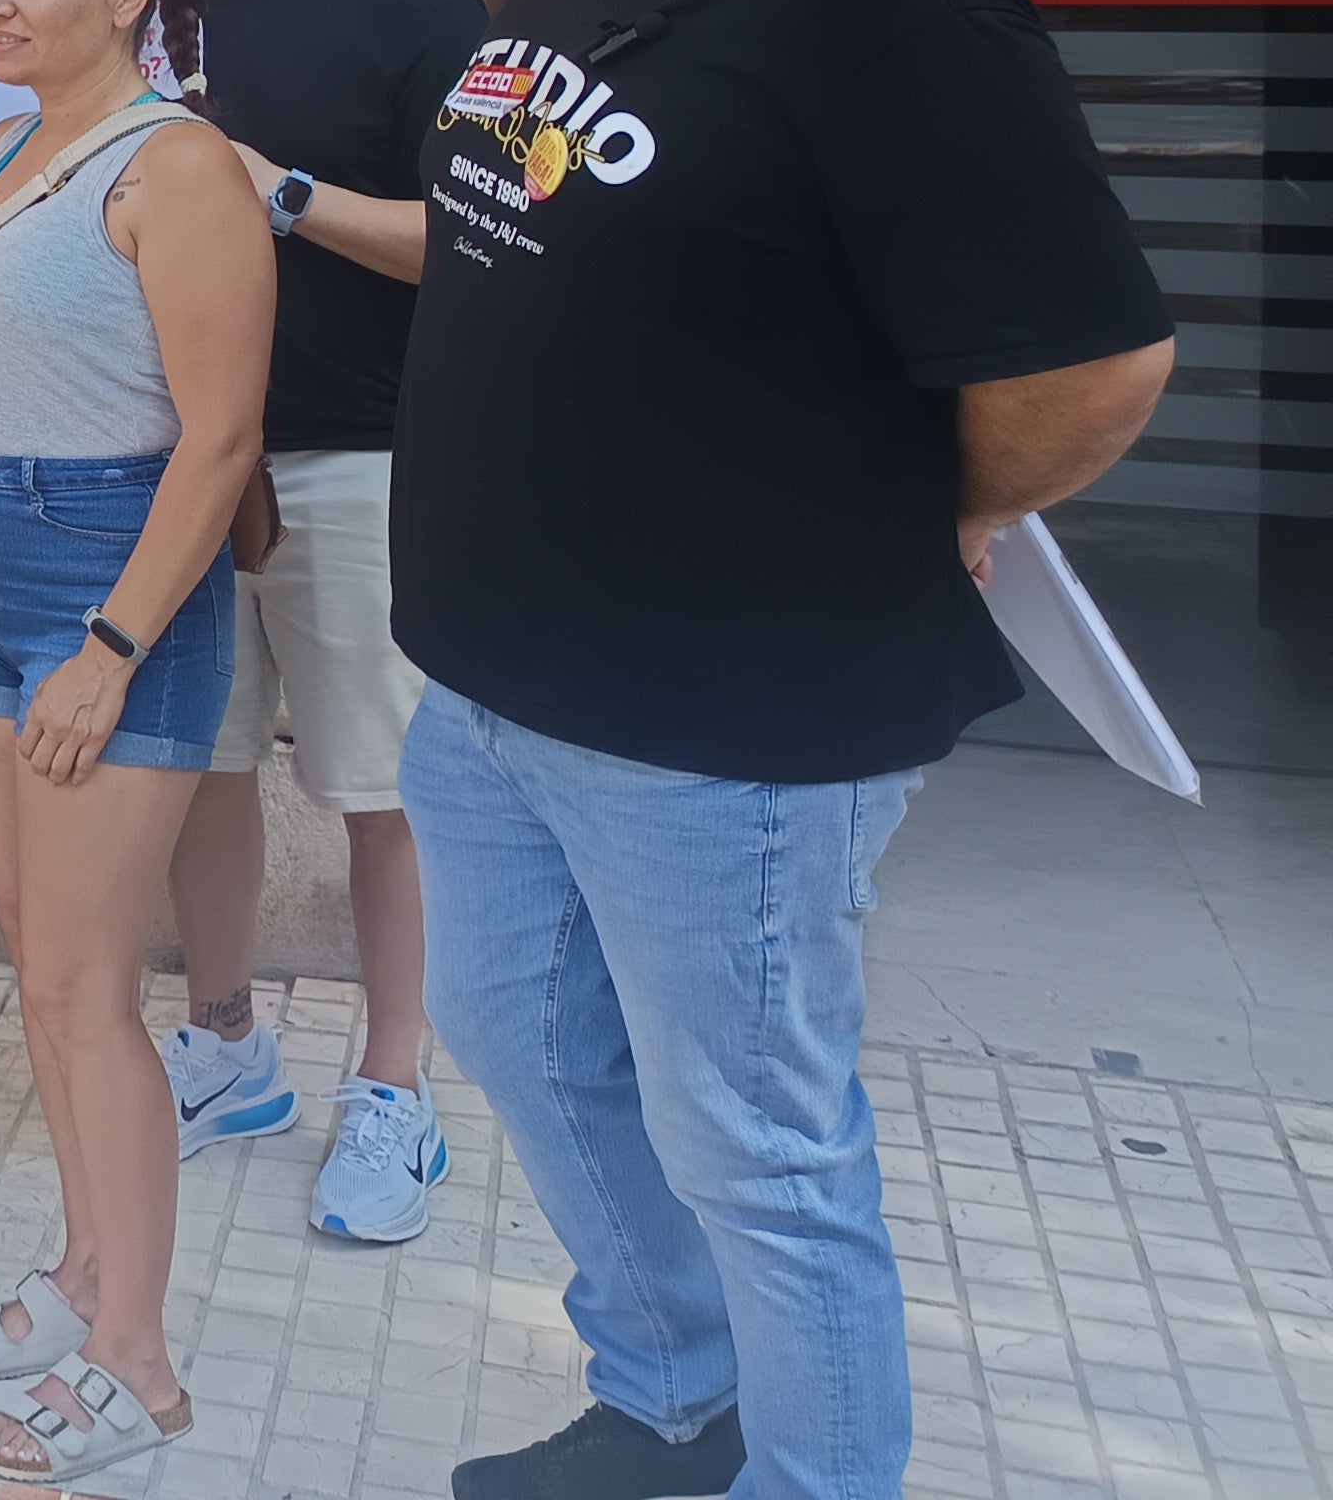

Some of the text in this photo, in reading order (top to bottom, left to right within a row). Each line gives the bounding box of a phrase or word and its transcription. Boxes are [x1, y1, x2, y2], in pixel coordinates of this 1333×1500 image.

[467, 71, 511, 92] CCOO
[450, 154, 529, 212] SINCE 1990
[432, 182, 543, 254] Designed by the J&J crew
